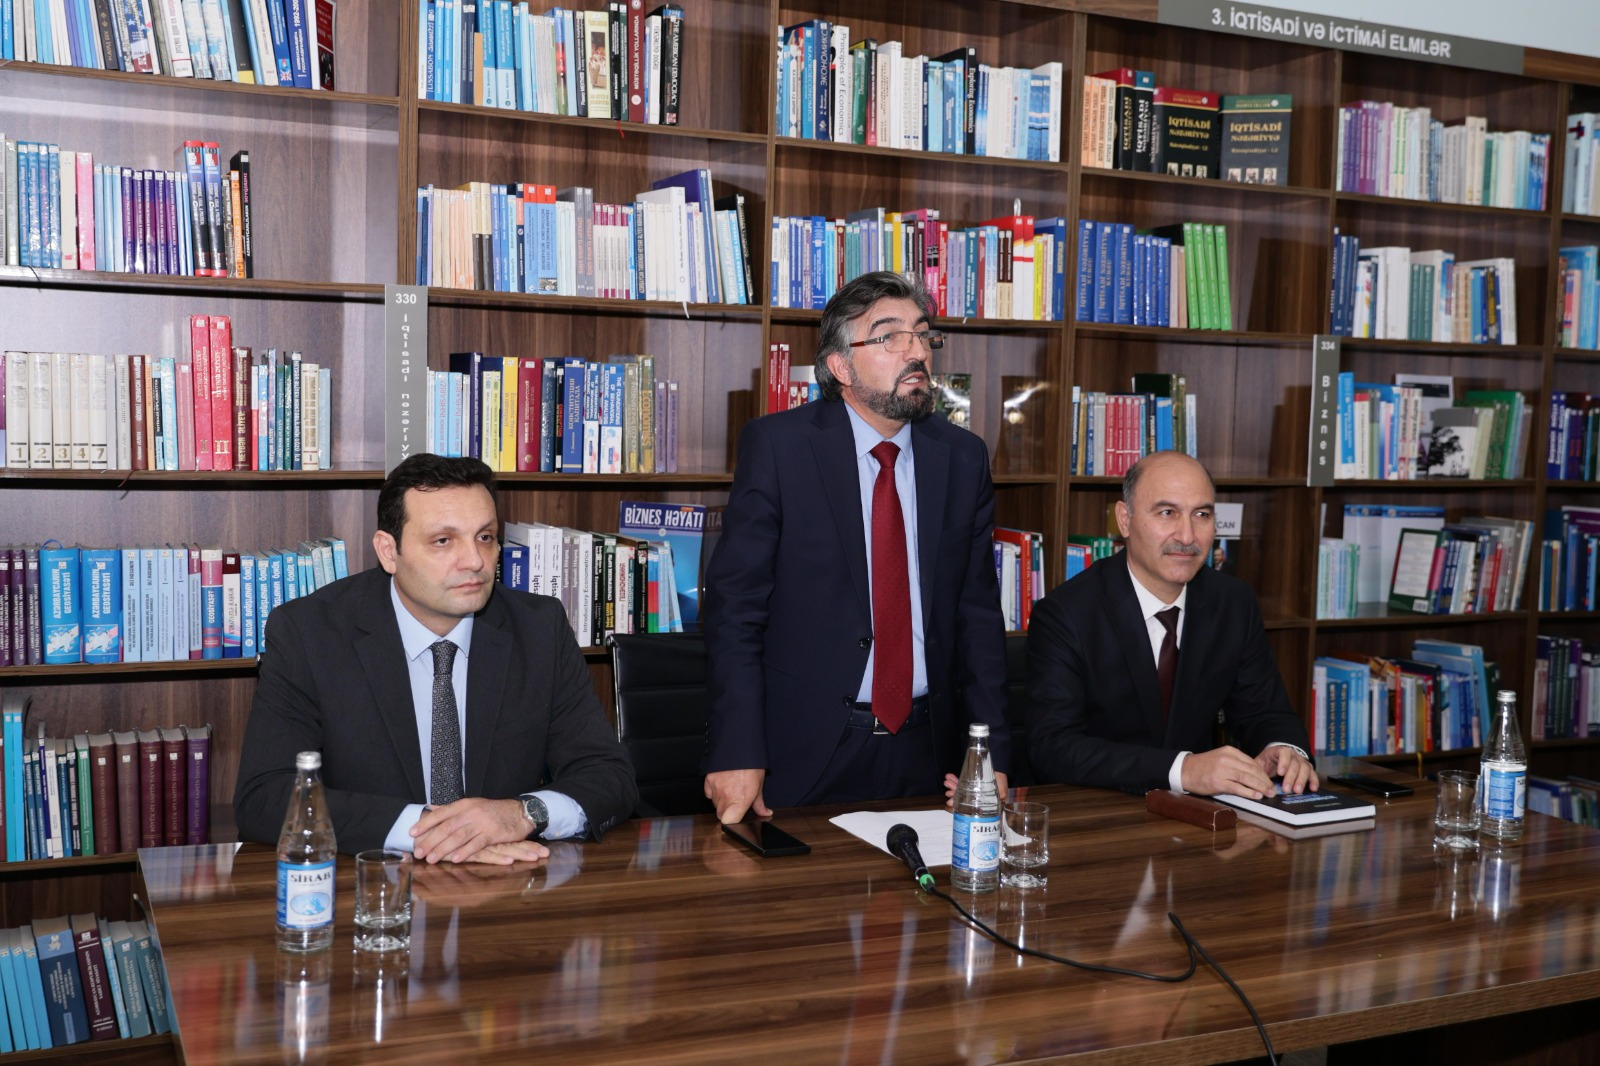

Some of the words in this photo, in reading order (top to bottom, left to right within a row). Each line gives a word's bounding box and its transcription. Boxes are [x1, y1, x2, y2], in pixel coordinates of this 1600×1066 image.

[291, 0, 302, 28] 1992-200
[672, 21, 680, 32] THE
[632, 15, 641, 51] YOLLARINDA
[1211, 7, 1225, 26] 3.
[1229, 6, 1299, 36] İQTİSADİ
[1302, 21, 1326, 40] VƏ
[1328, 21, 1386, 48] İCTİMAİ
[1389, 33, 1451, 58] ELMLƏR
[671, 33, 680, 67] AMERICAN
[838, 33, 848, 74] Principles
[671, 67, 679, 107] DEMOCRACY
[806, 45, 814, 122] MACROECONOMICS
[838, 77, 848, 87] of
[966, 67, 976, 99] Exploring
[838, 89, 847, 136] Economics
[967, 99, 975, 133] Economics
[1135, 99, 1145, 153] İQTİSADİ
[1168, 115, 1211, 130] İQTİSADİ
[1230, 121, 1282, 133] İQTİSADİ
[1168, 129, 1210, 139] NƏZƏRİYYƏ
[1231, 134, 1281, 142] NƏZƏRİYYƏ
[1080, 230, 1089, 272] NƏZƏRİYYƏ
[1100, 232, 1108, 274] NƏZƏRİYYƏ
[394, 292, 417, 305] 330
[1079, 274, 1087, 308] İQTİSADİ
[1098, 276, 1106, 310] İQTİSADİ
[1118, 277, 1126, 310] İQTİSADİ
[1320, 340, 1336, 351] 334
[401, 393, 411, 460] nəzəriyy
[641, 389, 653, 446] Economics
[1319, 375, 1331, 466] Biznes
[16, 447, 22, 458] 1
[37, 447, 47, 459] 2
[58, 447, 67, 459] 3
[77, 447, 86, 459] 4
[95, 447, 105, 459] 7
[237, 437, 247, 462] HEYDƏR
[624, 504, 663, 525] BİZNES
[664, 509, 704, 528] HƏYATI
[243, 565, 252, 580] ÖMÜ
[258, 566, 266, 581] ÖMÜ
[533, 574, 543, 596] İqtisa
[551, 575, 561, 597] İqtisa
[582, 549, 590, 593] Econometrics
[51, 568, 62, 619] AZƏRBAYCANIN
[61, 571, 72, 614] GEOSİYASƏTİ
[91, 568, 101, 619] AZƏRBAYCANIN
[101, 572, 111, 615] GEOSİYASƏTİ
[207, 590, 216, 624] GEOSİYASƏT
[582, 594, 590, 633] Introductory
